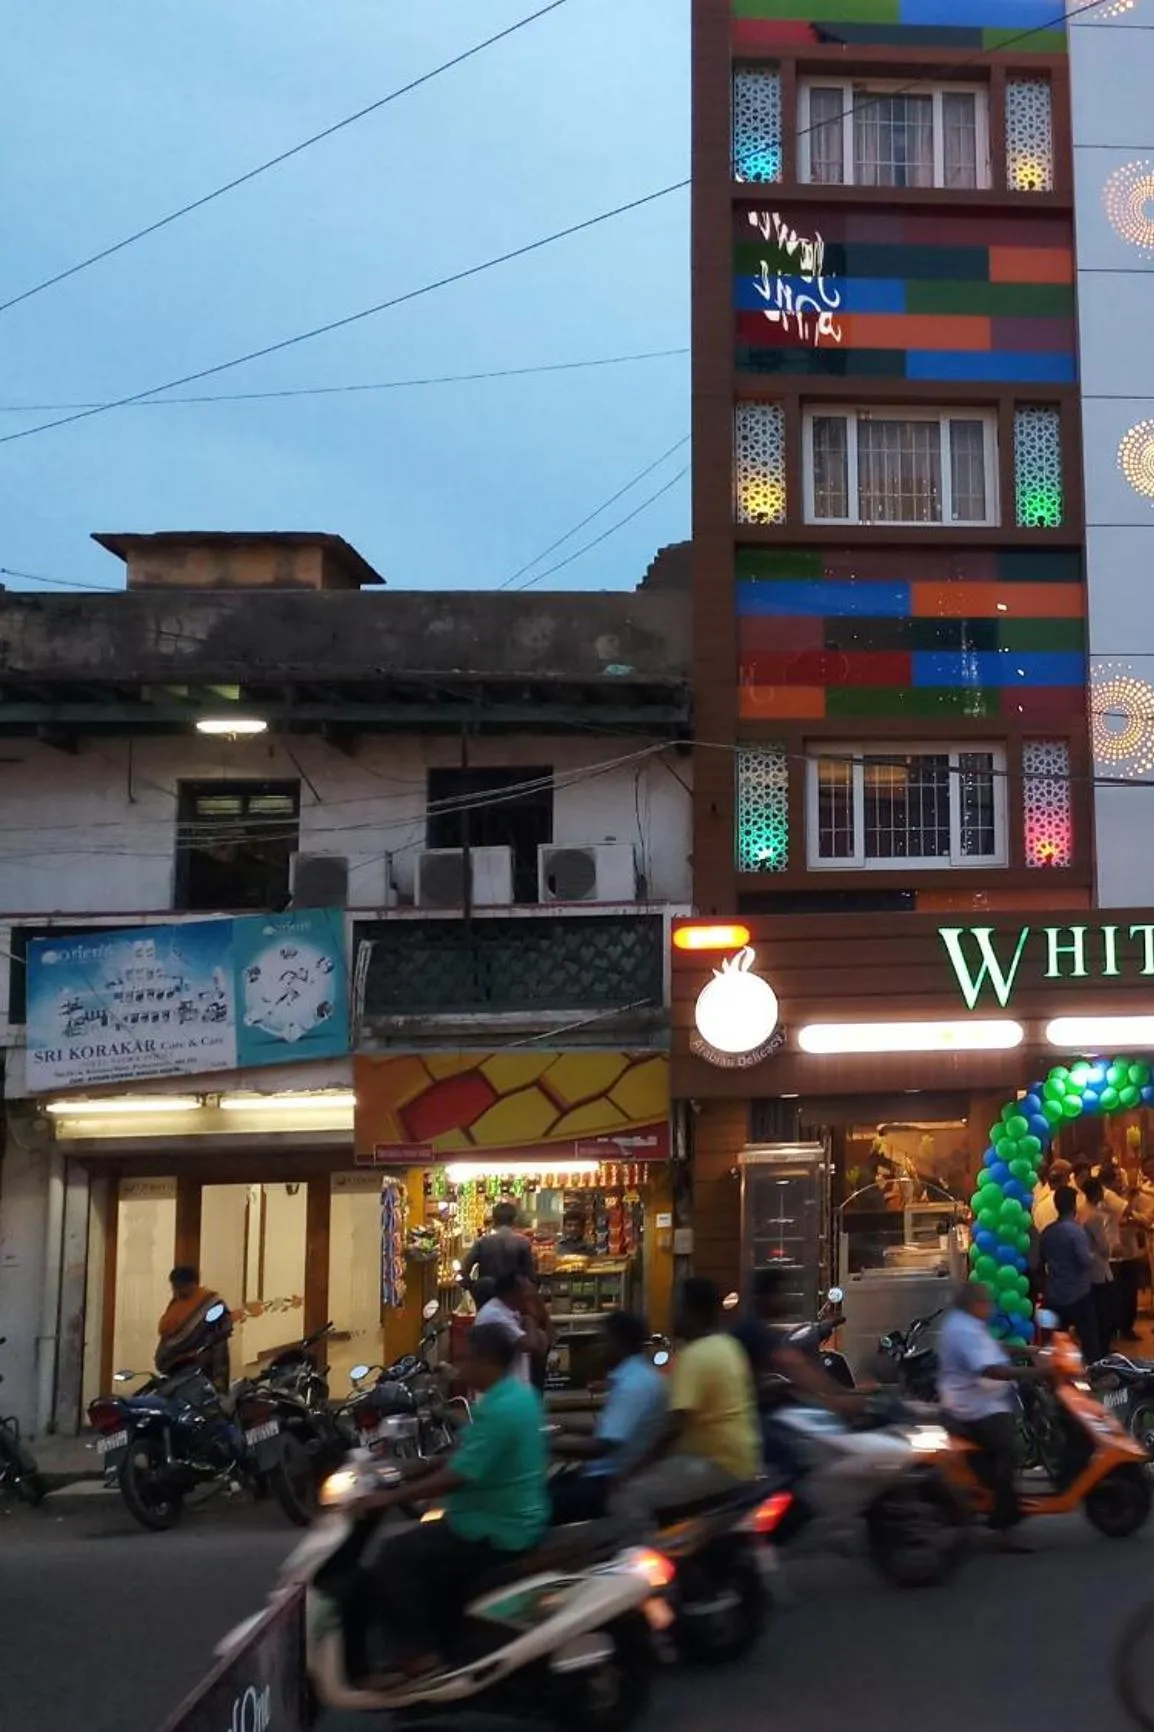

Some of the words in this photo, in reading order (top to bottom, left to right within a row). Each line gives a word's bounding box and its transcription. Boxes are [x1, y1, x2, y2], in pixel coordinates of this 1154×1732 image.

[33, 1050, 63, 1064] SRI
[69, 1039, 156, 1060] KORAKAR
[737, 1033, 783, 1067] Delicacy
